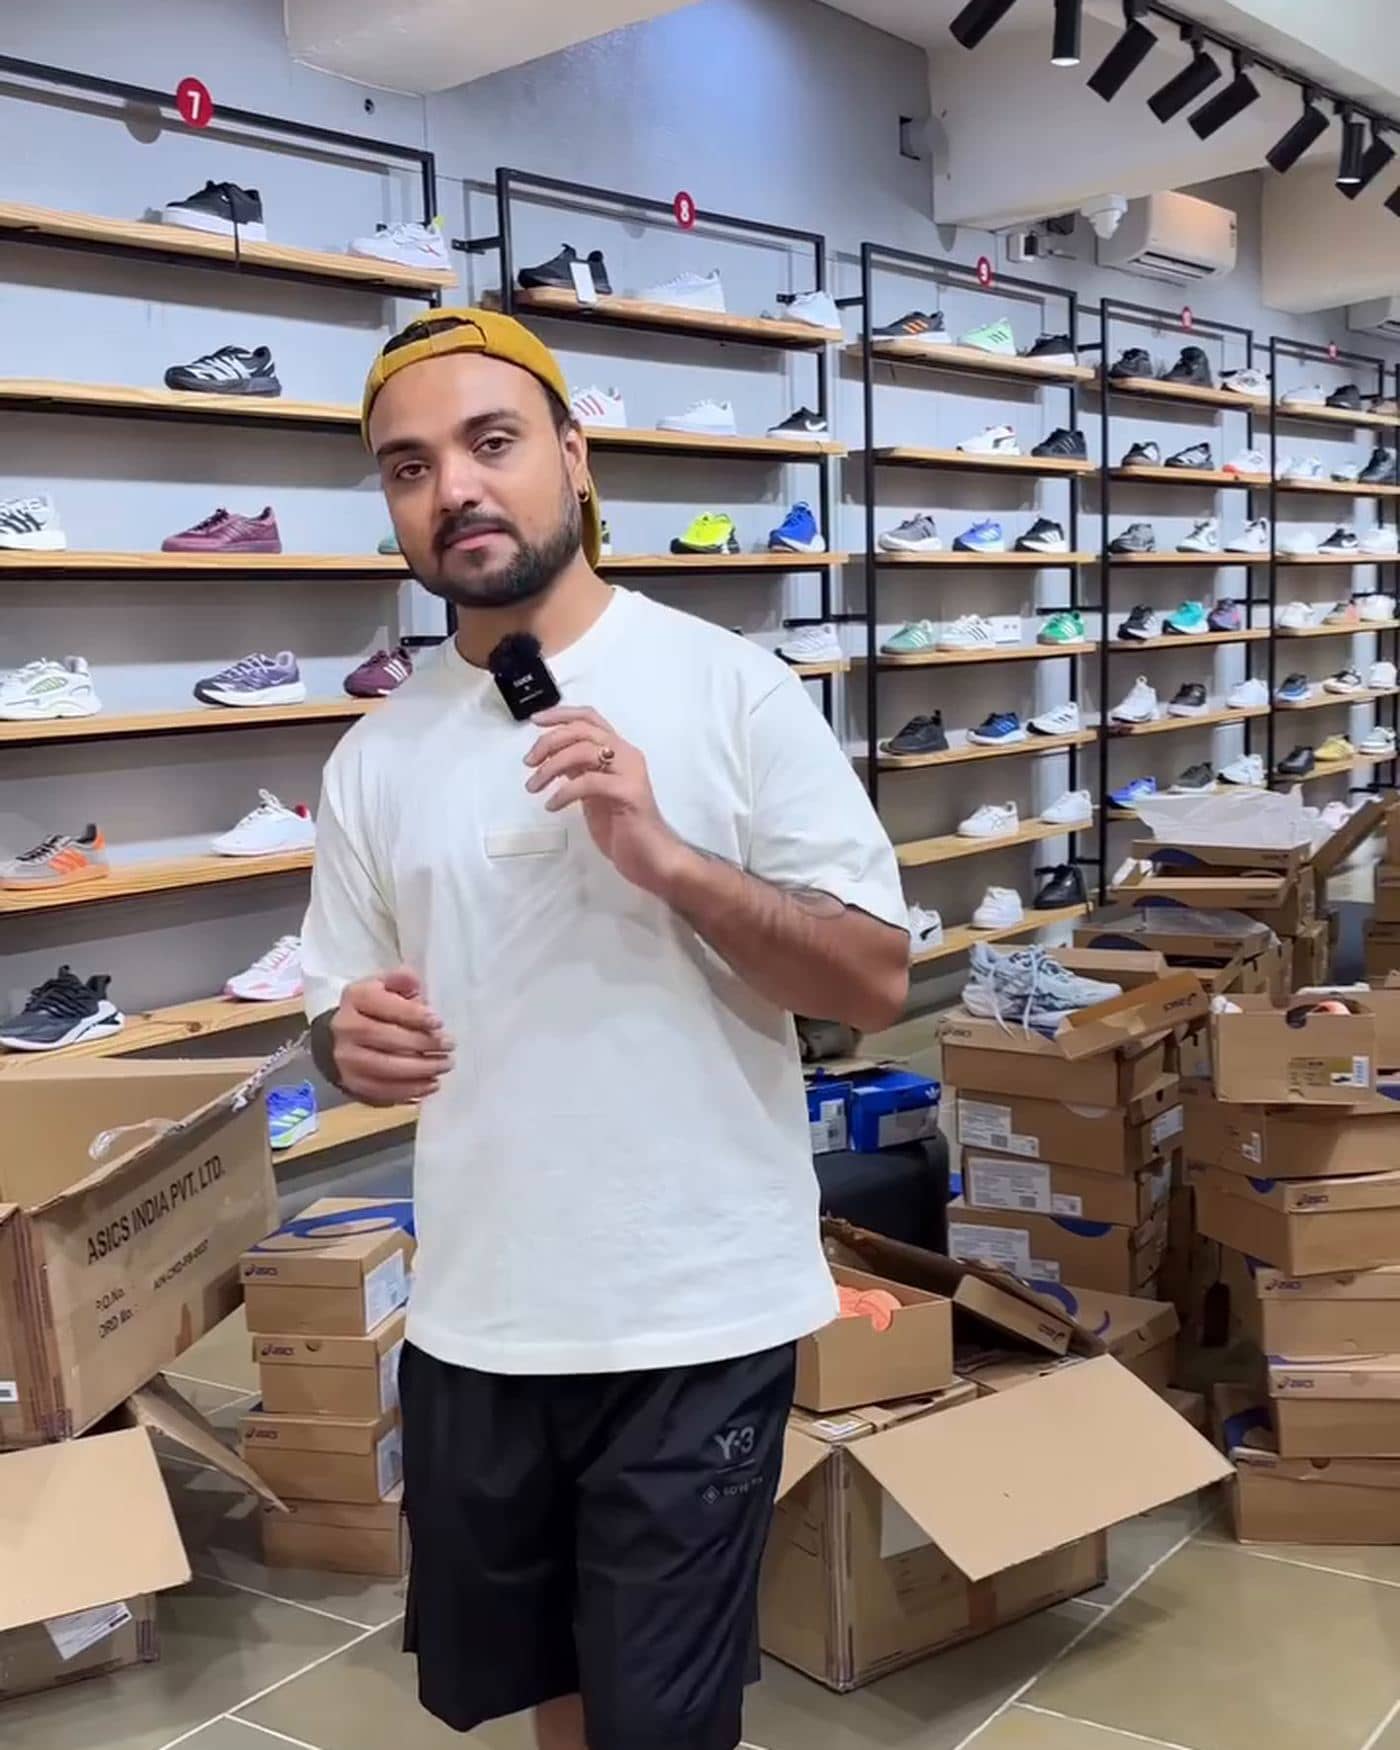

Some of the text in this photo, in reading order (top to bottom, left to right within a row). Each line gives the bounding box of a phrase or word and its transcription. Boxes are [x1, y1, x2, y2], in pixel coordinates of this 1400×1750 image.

[187, 90, 201, 120] 7
[680, 199, 690, 222] 8
[87, 1216, 131, 1265] ASICS
[131, 1190, 171, 1236] INDIA
[169, 1171, 199, 1209] PVT.
[199, 1154, 226, 1190] LTD.
